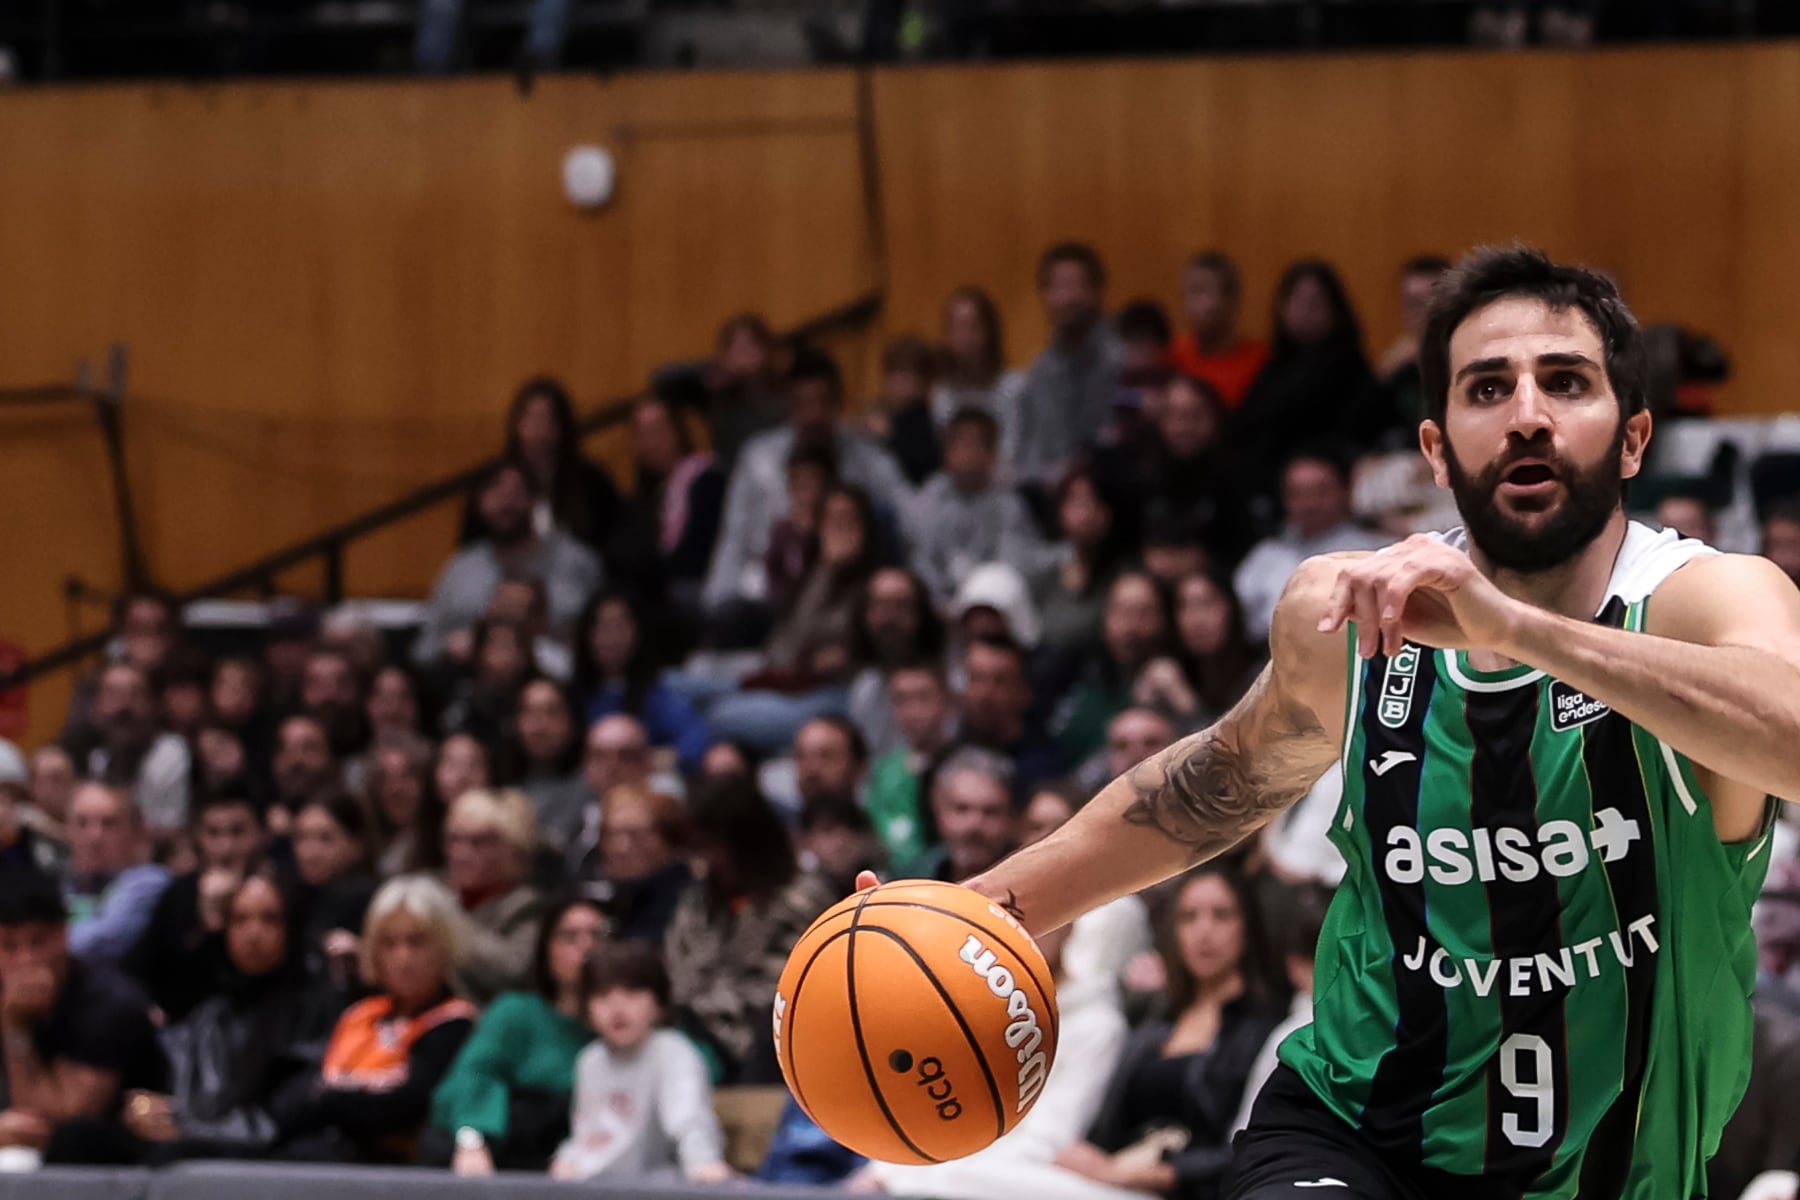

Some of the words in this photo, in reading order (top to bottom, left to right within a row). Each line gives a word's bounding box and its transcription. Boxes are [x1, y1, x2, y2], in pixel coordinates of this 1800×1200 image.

[1557, 693, 1583, 710] liga
[1402, 913, 1660, 998] JOVENTUT
[915, 1056, 963, 1122] acb
[1498, 1033, 1554, 1148] 9
